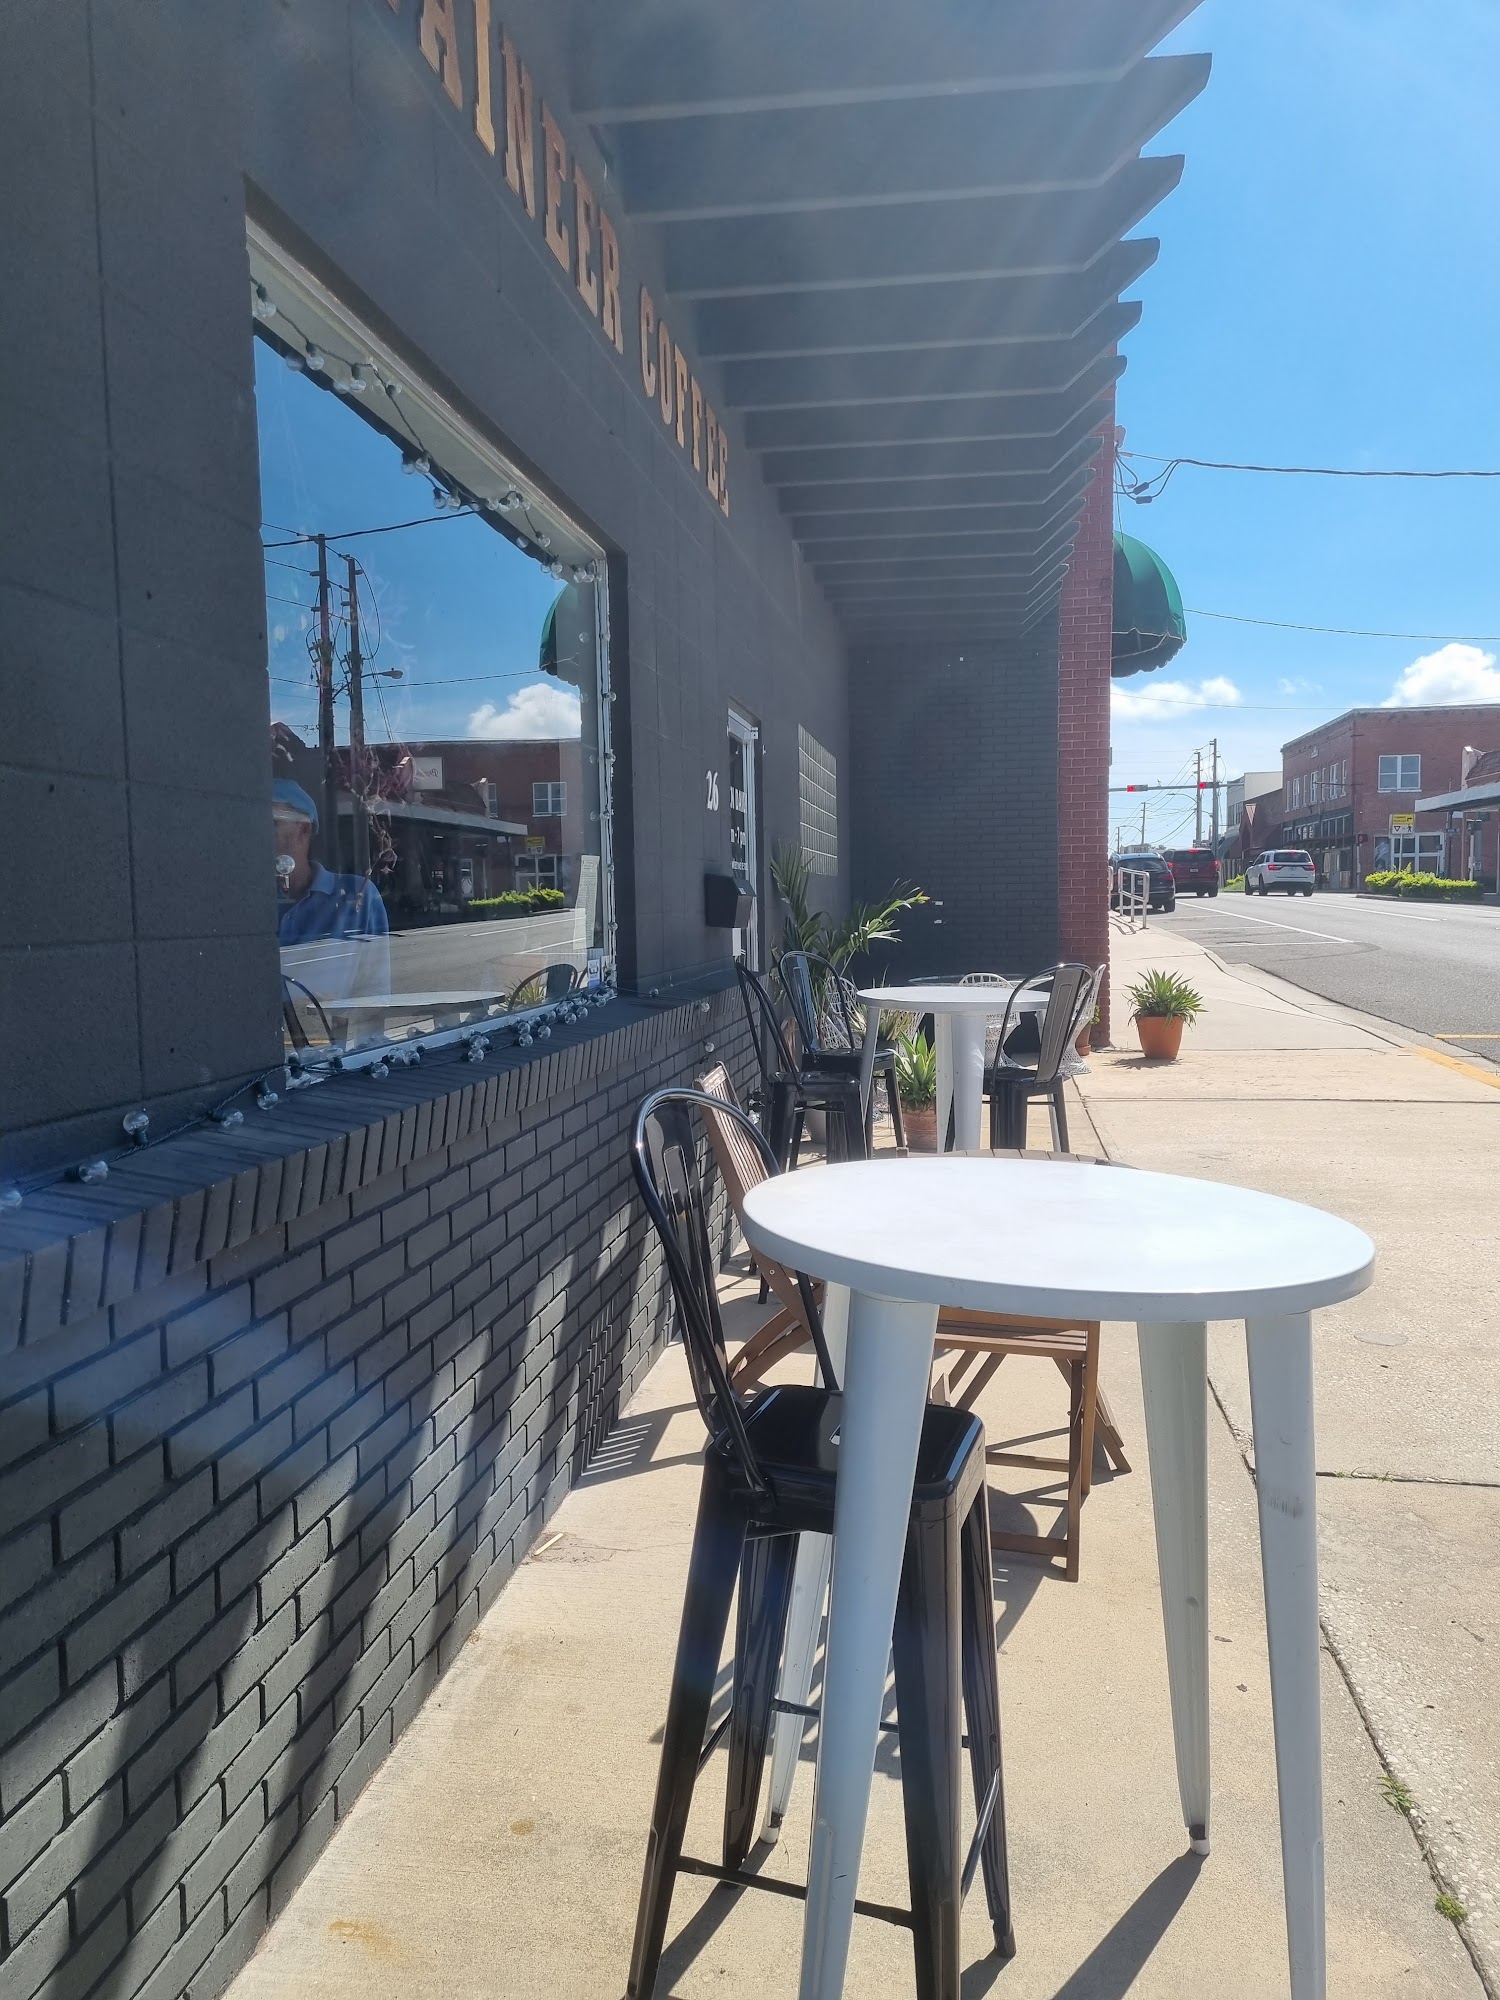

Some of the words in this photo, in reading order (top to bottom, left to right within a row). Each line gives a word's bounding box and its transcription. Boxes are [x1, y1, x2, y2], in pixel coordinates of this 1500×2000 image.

[385, 0, 623, 355] AINEER
[640, 285, 729, 517] COFFEE
[705, 769, 719, 811] 26
